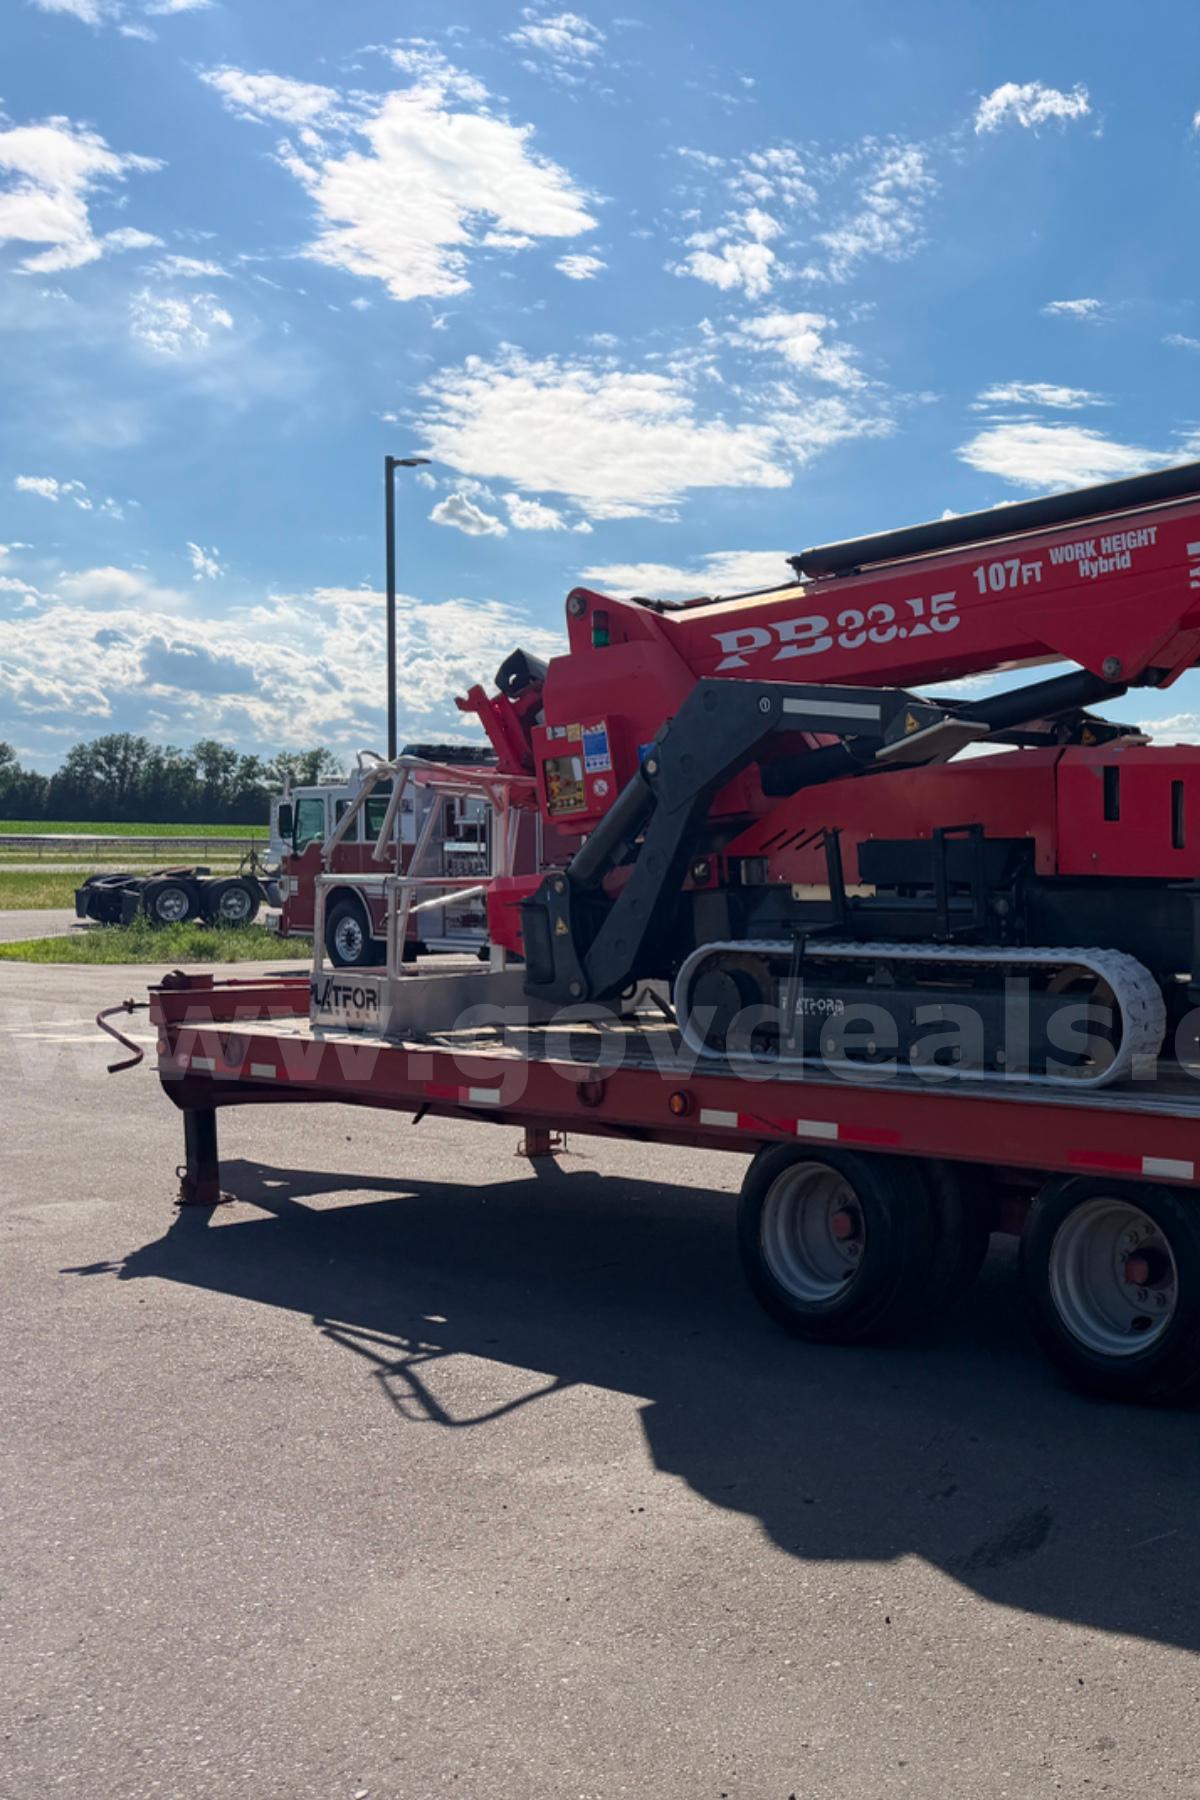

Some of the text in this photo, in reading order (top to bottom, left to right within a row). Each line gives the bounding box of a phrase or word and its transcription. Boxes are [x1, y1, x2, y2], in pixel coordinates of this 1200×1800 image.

[1049, 527, 1158, 565] WORK HEIGHT
[972, 558, 1043, 595] 107FT
[1079, 551, 1132, 579] Hybrid
